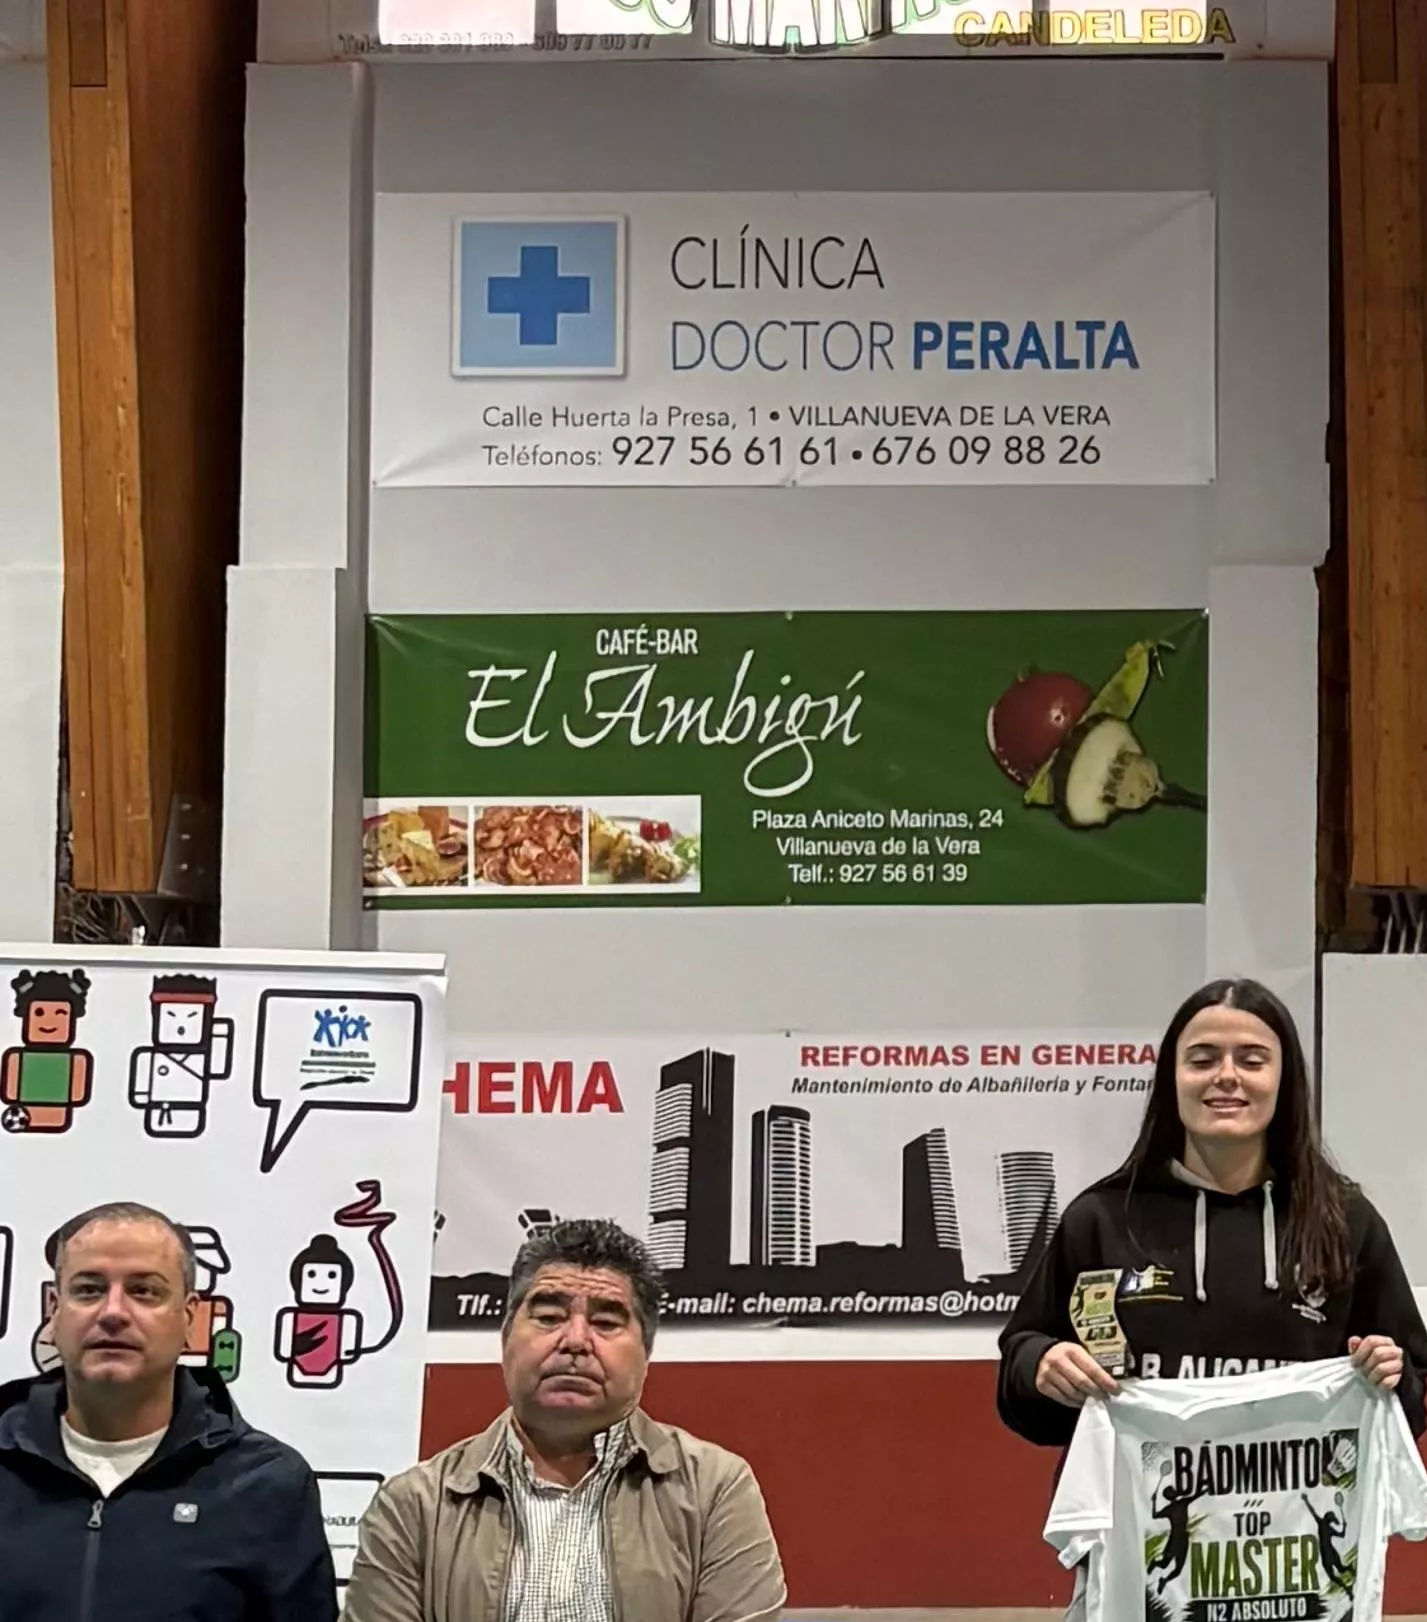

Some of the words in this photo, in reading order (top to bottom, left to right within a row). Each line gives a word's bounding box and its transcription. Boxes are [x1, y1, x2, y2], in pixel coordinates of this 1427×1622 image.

[952, 8, 1235, 47] CANDELEDA
[671, 225, 884, 291] CLÍNICA
[671, 320, 895, 373] DOCTOR
[912, 322, 1140, 370] PERALTA
[482, 405, 543, 428] Calle
[552, 405, 631, 429] Huerta
[641, 405, 659, 427] la
[667, 405, 737, 432] Presa,
[748, 405, 759, 427] 1
[789, 405, 952, 428] VILLANUEVA
[960, 405, 996, 427] DE
[1005, 405, 1034, 427] LA
[1041, 405, 1111, 427] VERA
[482, 444, 602, 470] Teléfonos:
[612, 438, 676, 468] 927
[689, 438, 732, 468] 56
[744, 438, 784, 467] 61
[800, 438, 838, 467] 61
[873, 437, 939, 467] 676
[948, 437, 991, 466] 09
[1005, 437, 1046, 466] 88
[1058, 436, 1102, 466] 26
[595, 626, 698, 657] CAFÉ-BAR
[465, 650, 556, 747] El
[562, 649, 865, 796] Ambigú
[752, 809, 807, 831] Plaza
[813, 809, 884, 831] Aniceto
[890, 809, 974, 833] Marinas,
[980, 809, 1004, 831] 24
[776, 836, 878, 857] Villanueva
[884, 836, 908, 857] de
[914, 836, 930, 857] la
[934, 836, 980, 857] Vera
[788, 863, 834, 884] Telf.:
[839, 864, 876, 884] 927
[883, 864, 907, 884] 56
[913, 864, 936, 883] 61
[942, 863, 967, 883] 39
[800, 1044, 970, 1067] REFORMAS
[980, 1045, 1022, 1067] EN
[1032, 1043, 1157, 1066] GENERA
[441, 1061, 624, 1114] HEMA
[792, 1076, 934, 1095] Mantenimiento
[940, 1076, 962, 1094] de
[967, 1074, 1071, 1094] Albañilería
[1076, 1077, 1088, 1098] y
[458, 1294, 502, 1316] Tlf.:
[1233, 1512, 1271, 1537] TOP
[1190, 1534, 1319, 1598] MASTER
[1207, 1603, 1227, 1622] N2
[1232, 1597, 1307, 1620] ABSOLUTO
